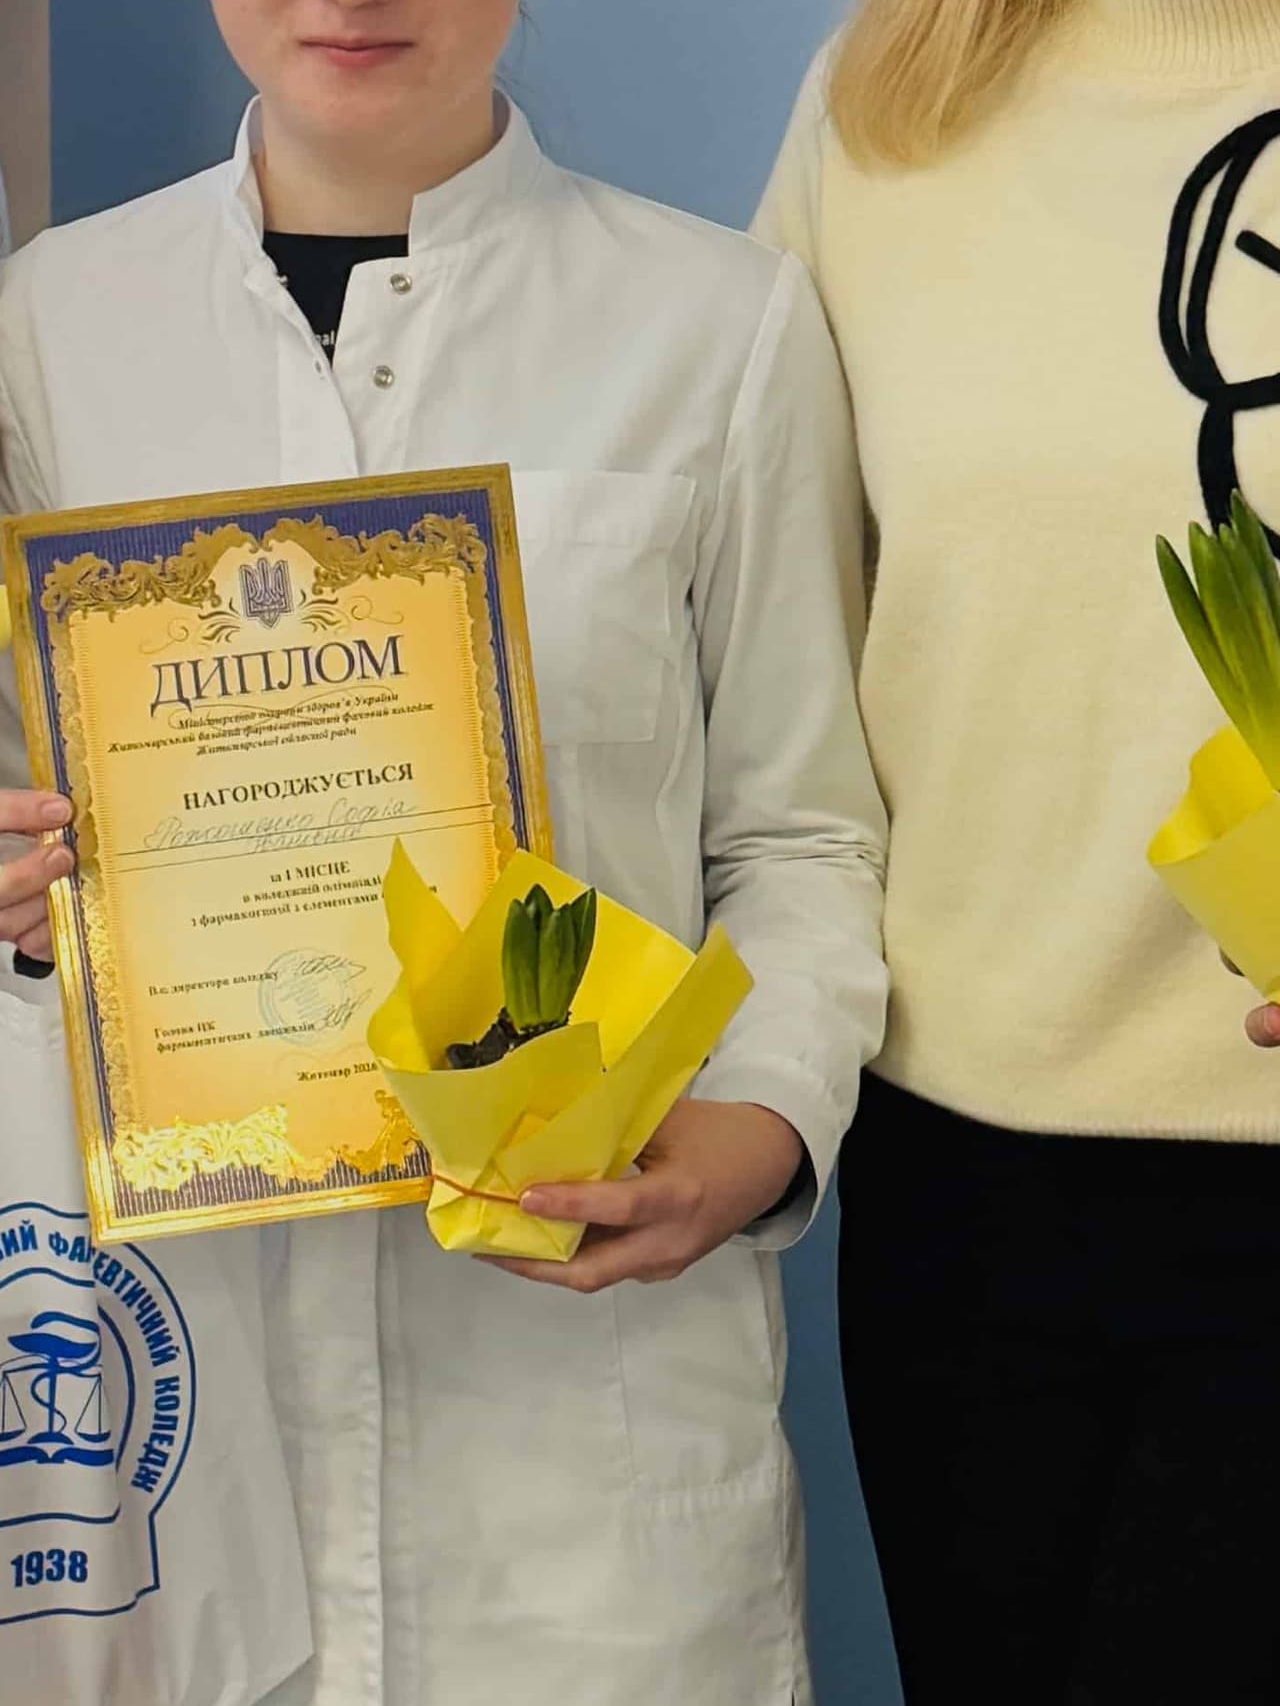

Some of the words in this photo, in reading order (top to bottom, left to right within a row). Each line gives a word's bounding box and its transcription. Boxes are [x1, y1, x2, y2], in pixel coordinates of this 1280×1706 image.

[150, 634, 407, 718] ДИПЛОМ
[182, 762, 414, 811] НАГОРОДЖУЄТЬСЯ
[295, 860, 351, 880] МІСЦЕ
[131, 1374, 181, 1494] КОЛЕДЖ
[10, 1548, 89, 1588] 1938
